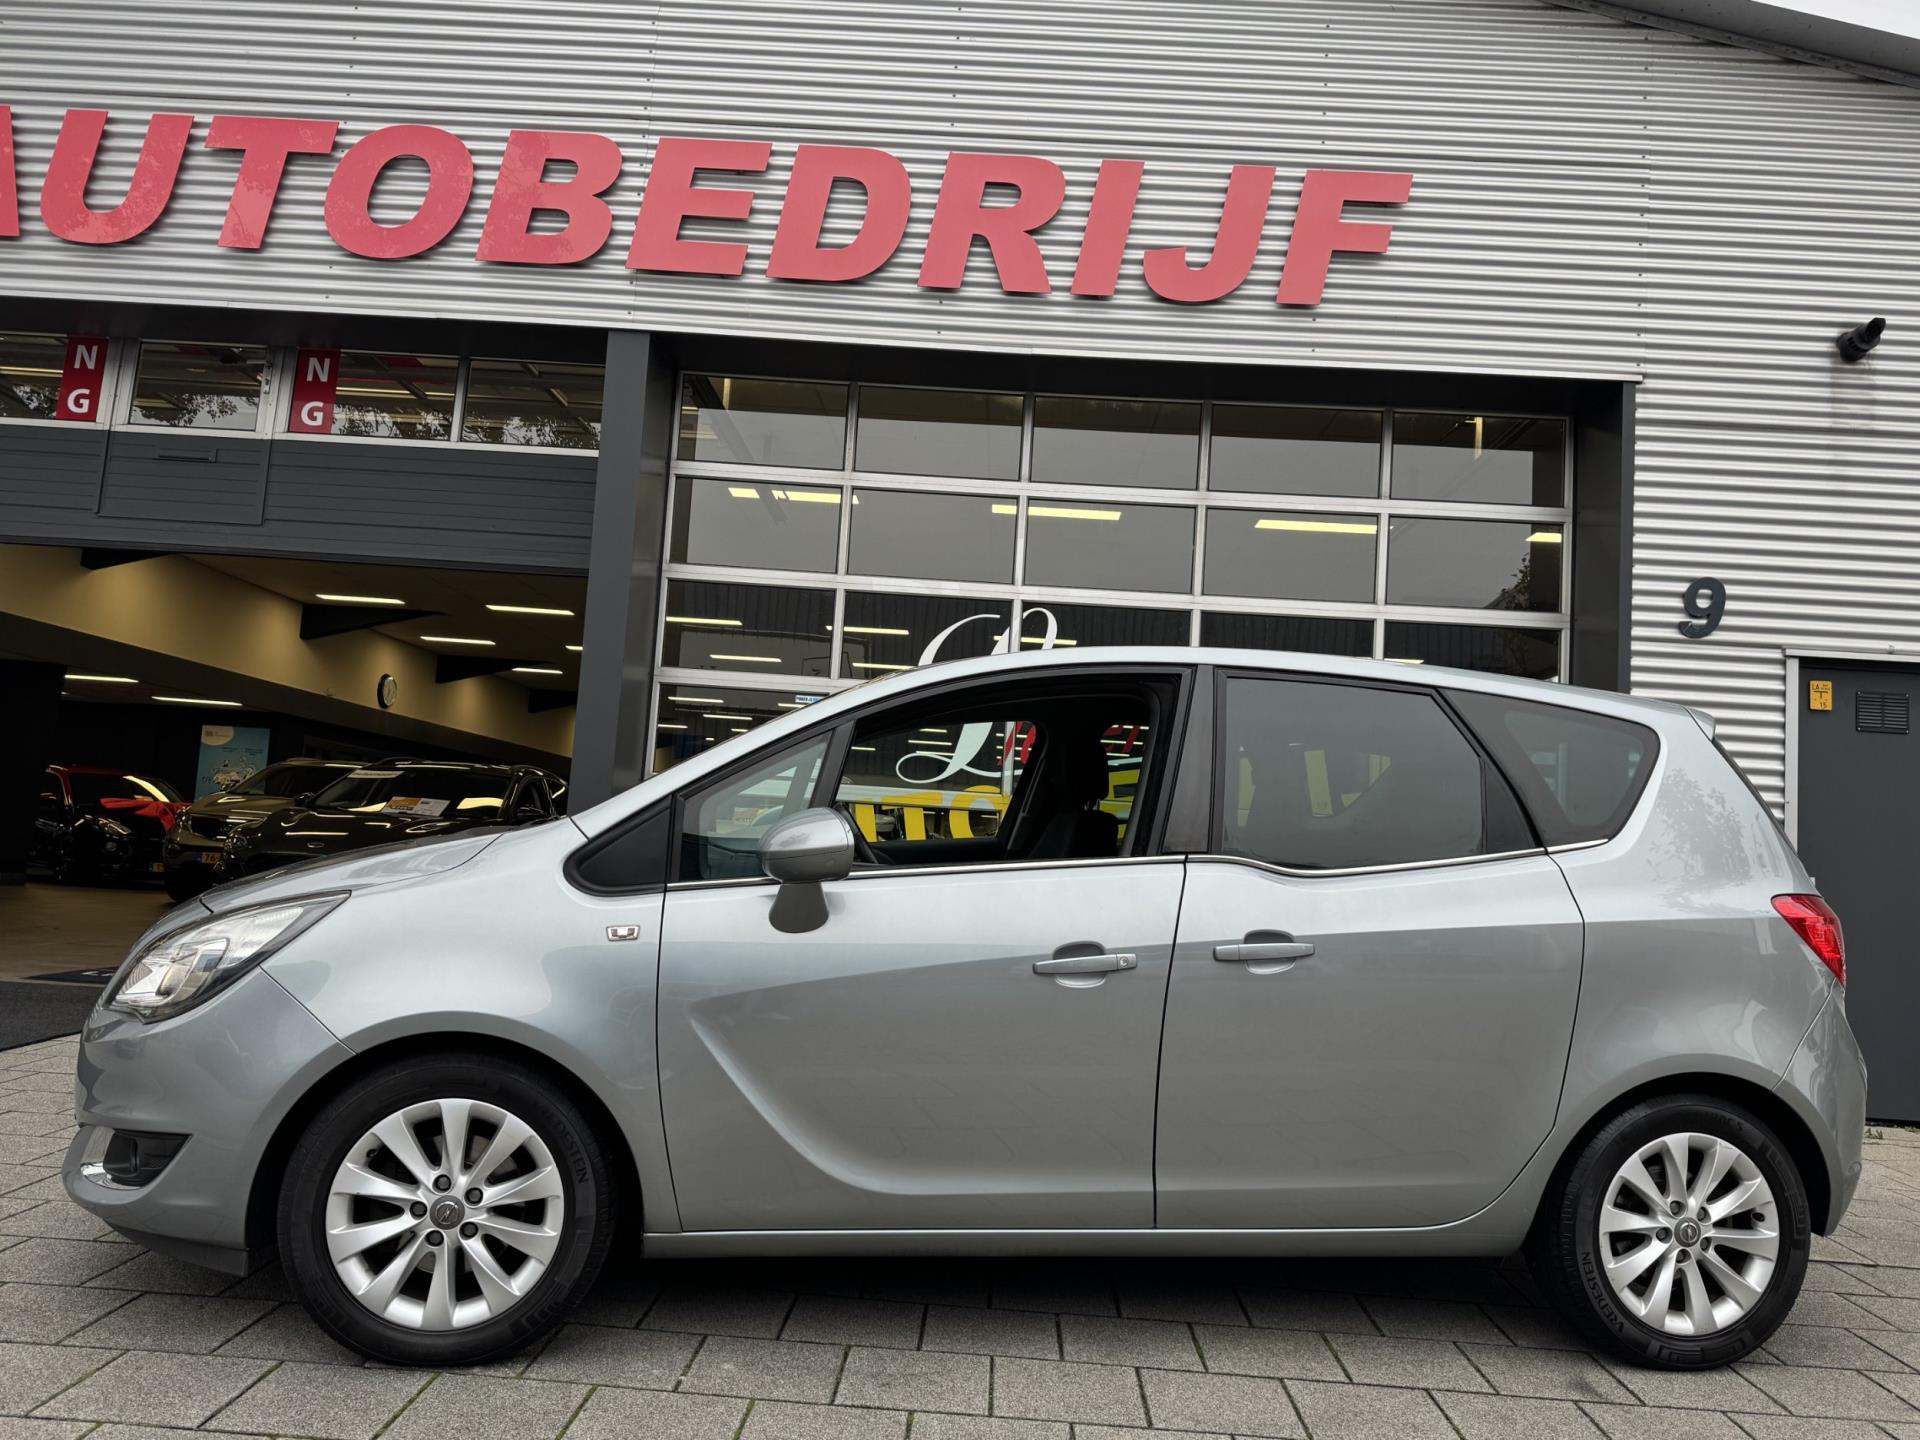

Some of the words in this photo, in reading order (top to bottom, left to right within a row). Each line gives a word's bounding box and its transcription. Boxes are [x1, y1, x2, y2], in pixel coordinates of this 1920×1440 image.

[0, 107, 1413, 306] UTOBEDRIJF
[1678, 577, 1726, 638] 9
[1581, 1251, 1625, 1333] VREDESTEIN
